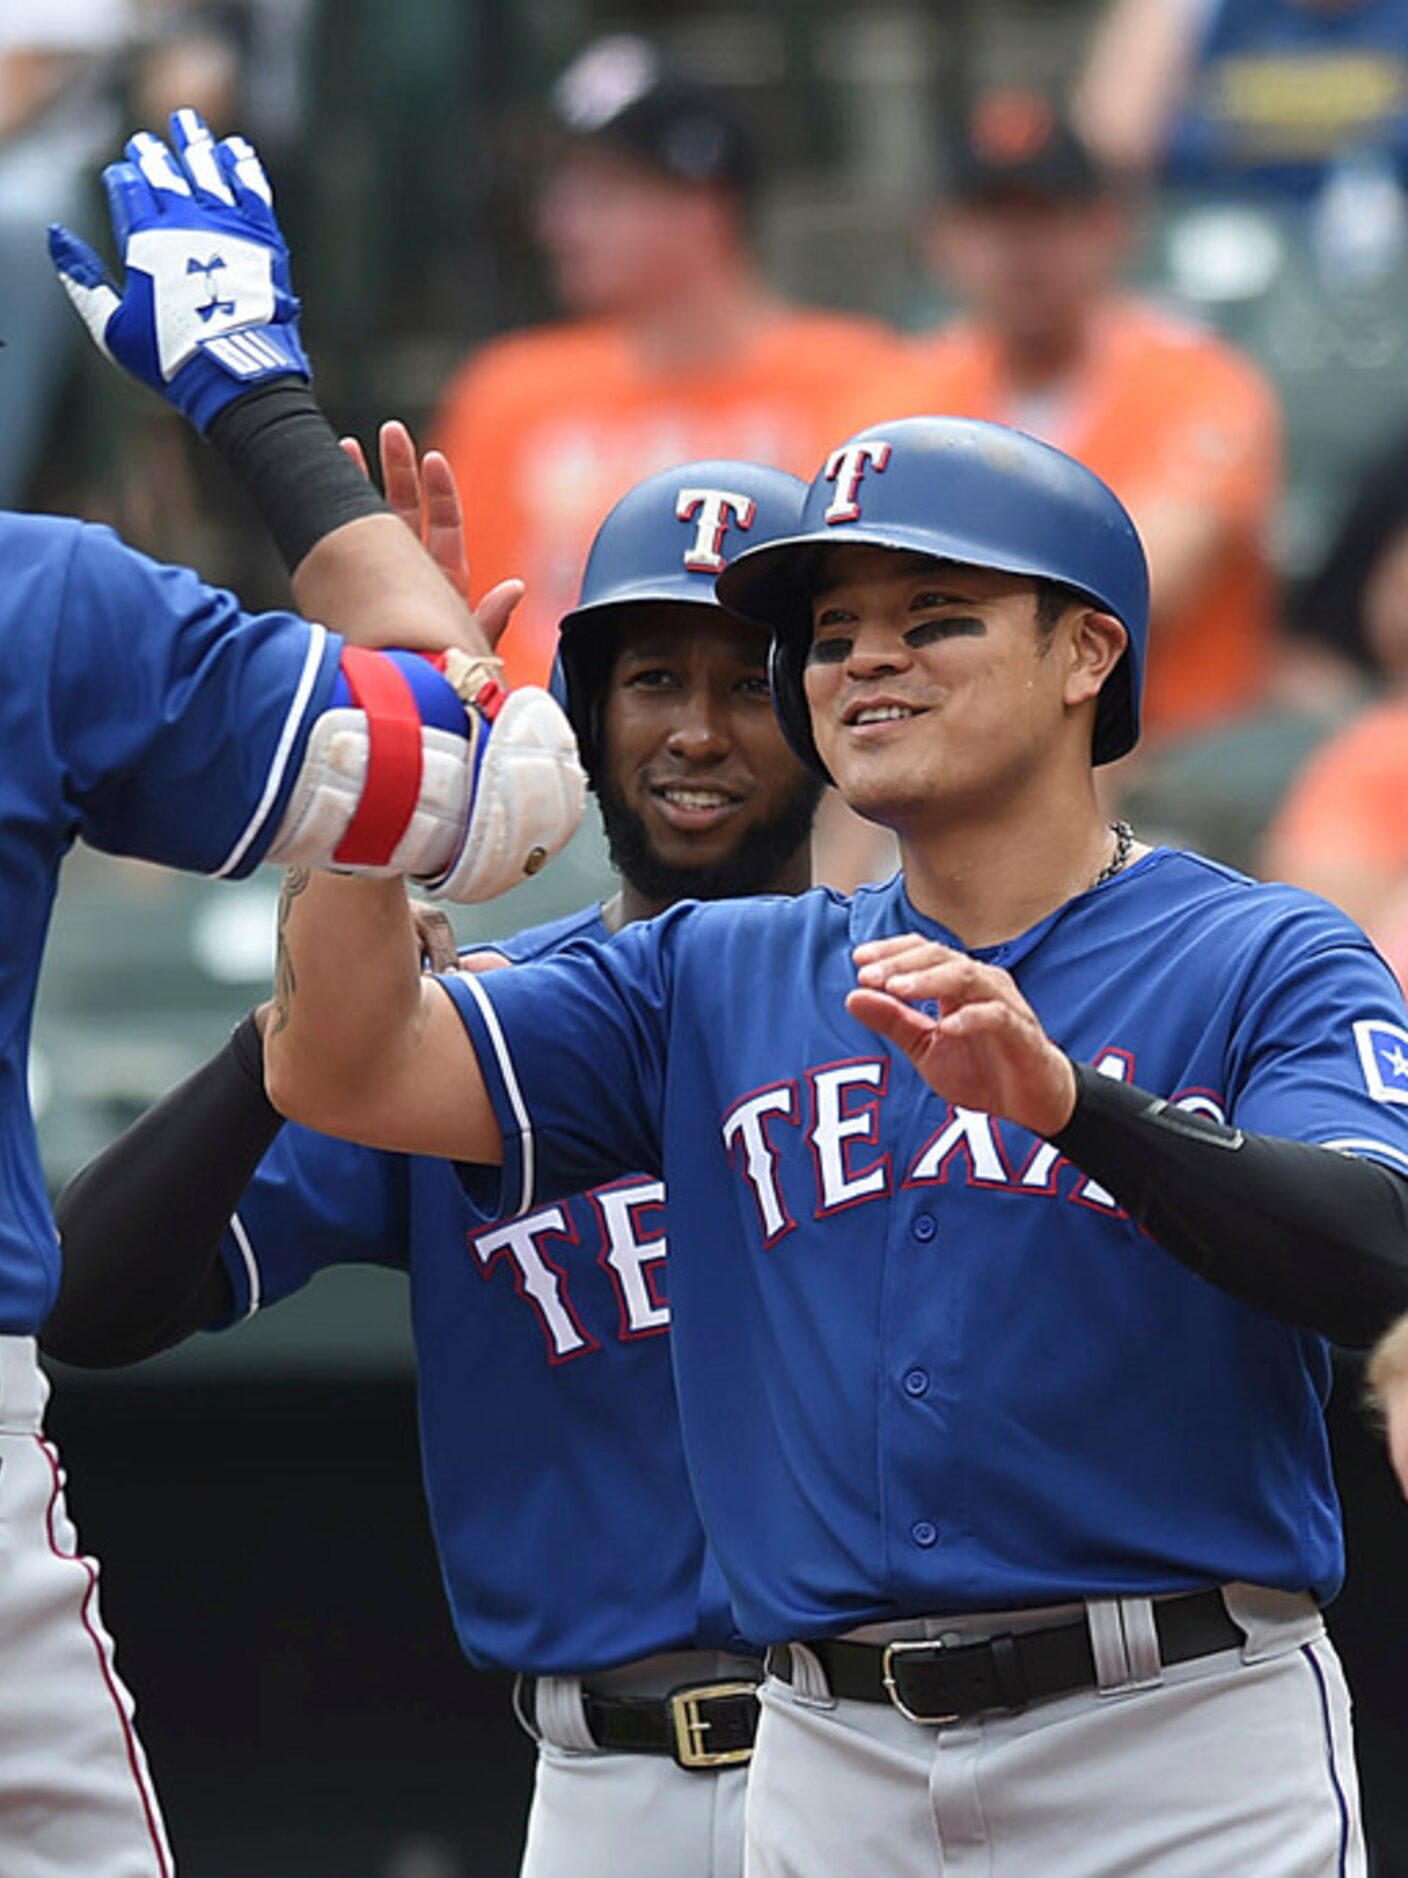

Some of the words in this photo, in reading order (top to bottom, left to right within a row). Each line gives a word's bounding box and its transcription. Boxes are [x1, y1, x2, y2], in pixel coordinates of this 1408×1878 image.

[825, 441, 892, 524] T
[675, 488, 756, 573] T
[466, 1173, 671, 1365] TE
